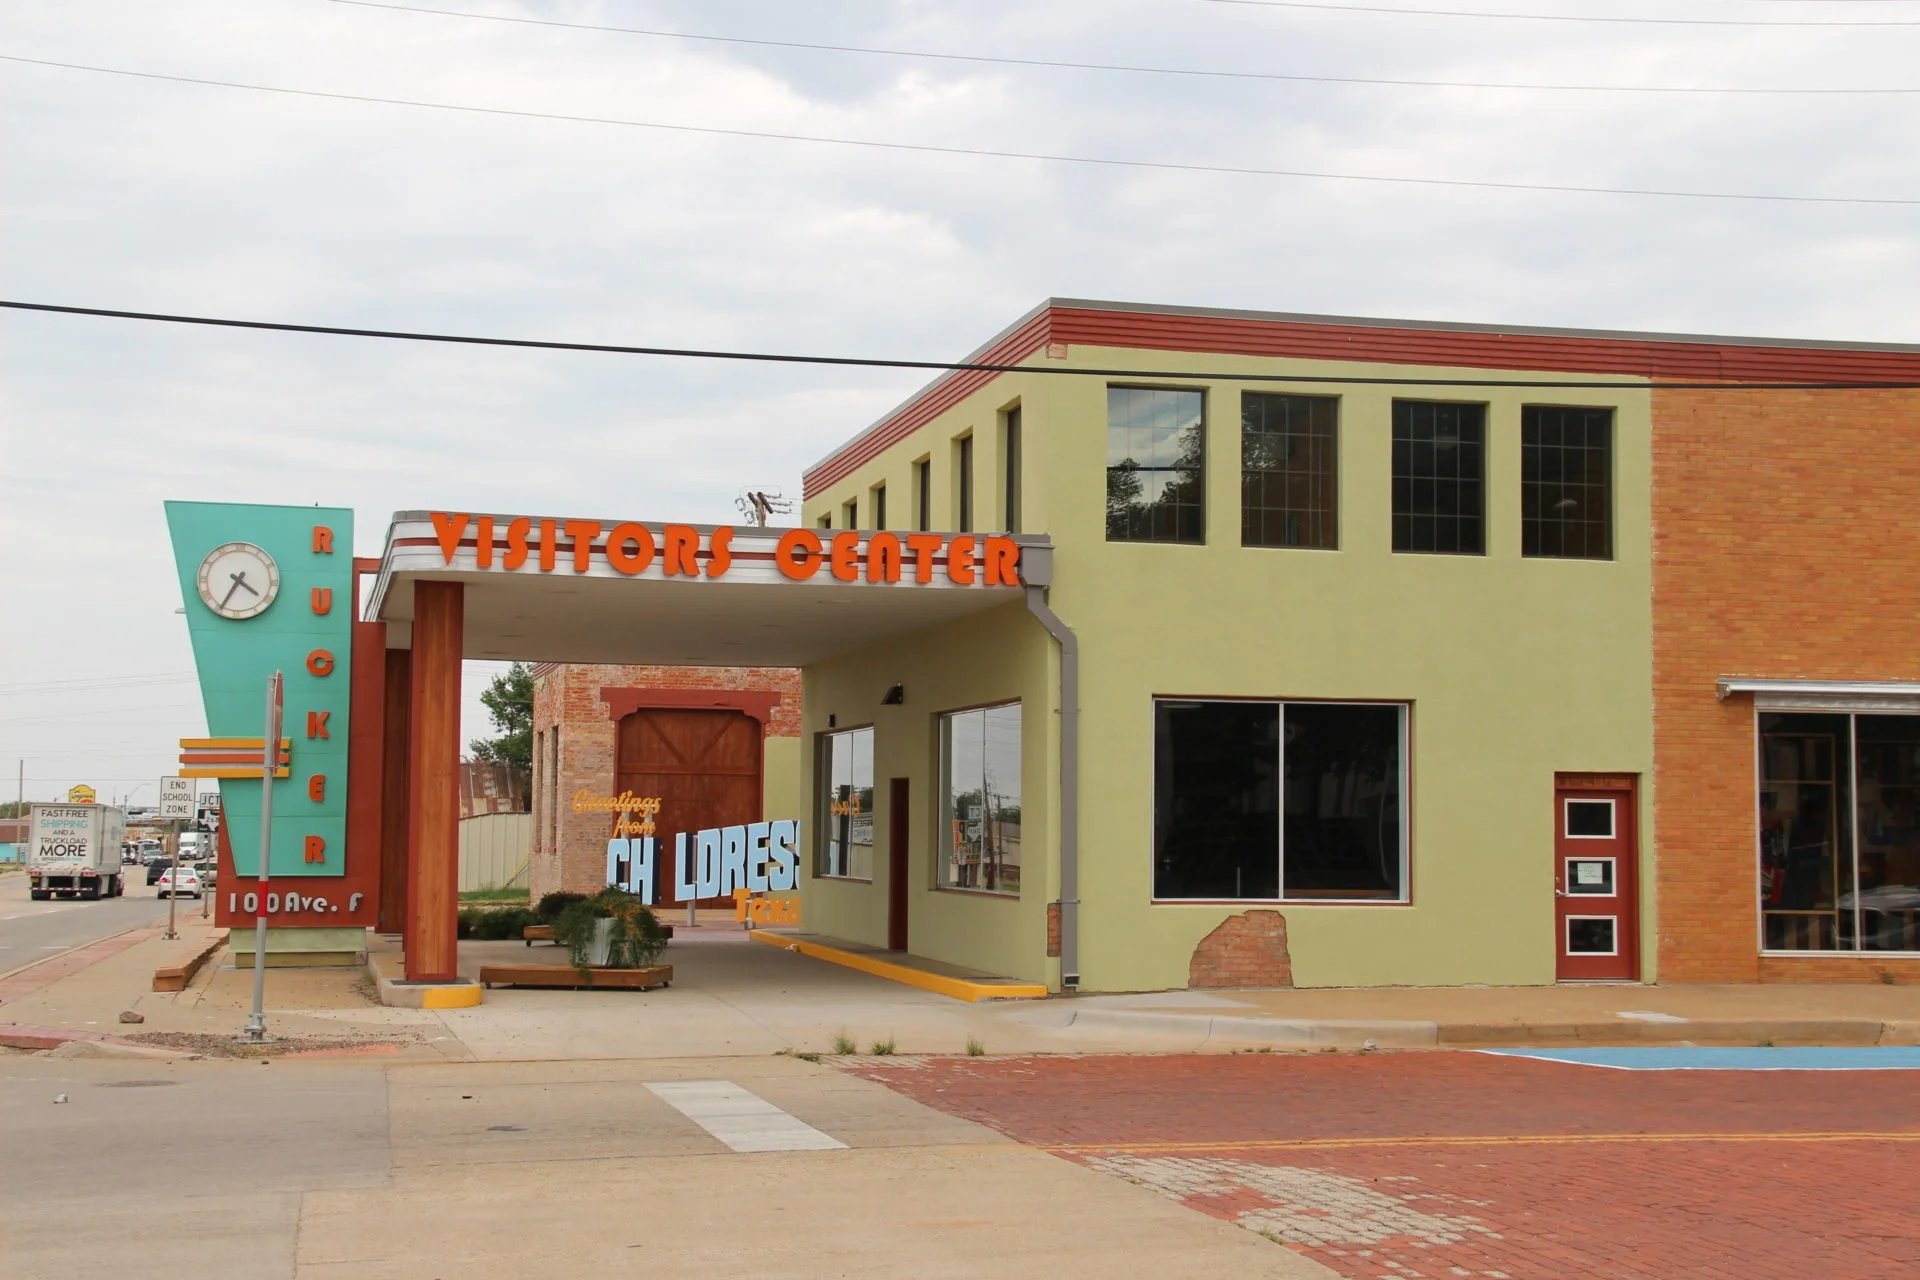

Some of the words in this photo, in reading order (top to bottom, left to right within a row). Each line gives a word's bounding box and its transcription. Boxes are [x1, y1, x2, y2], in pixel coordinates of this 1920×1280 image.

[429, 512, 733, 577] VISITORS
[776, 528, 1020, 586] CENTER
[304, 526, 334, 864] RUCKER
[170, 781, 186, 789] END
[163, 793, 193, 801] SCHOOL
[201, 795, 220, 805] JCT
[571, 787, 662, 817] Greetings
[41, 809, 64, 817] FAST
[66, 809, 88, 817] FREE
[166, 805, 188, 813] ZONE
[40, 819, 88, 828] SHIPPING
[613, 815, 656, 838] from
[39, 844, 87, 856] MORE
[229, 892, 279, 913] 100
[285, 892, 338, 912] Ave.
[732, 888, 800, 926] Texa
